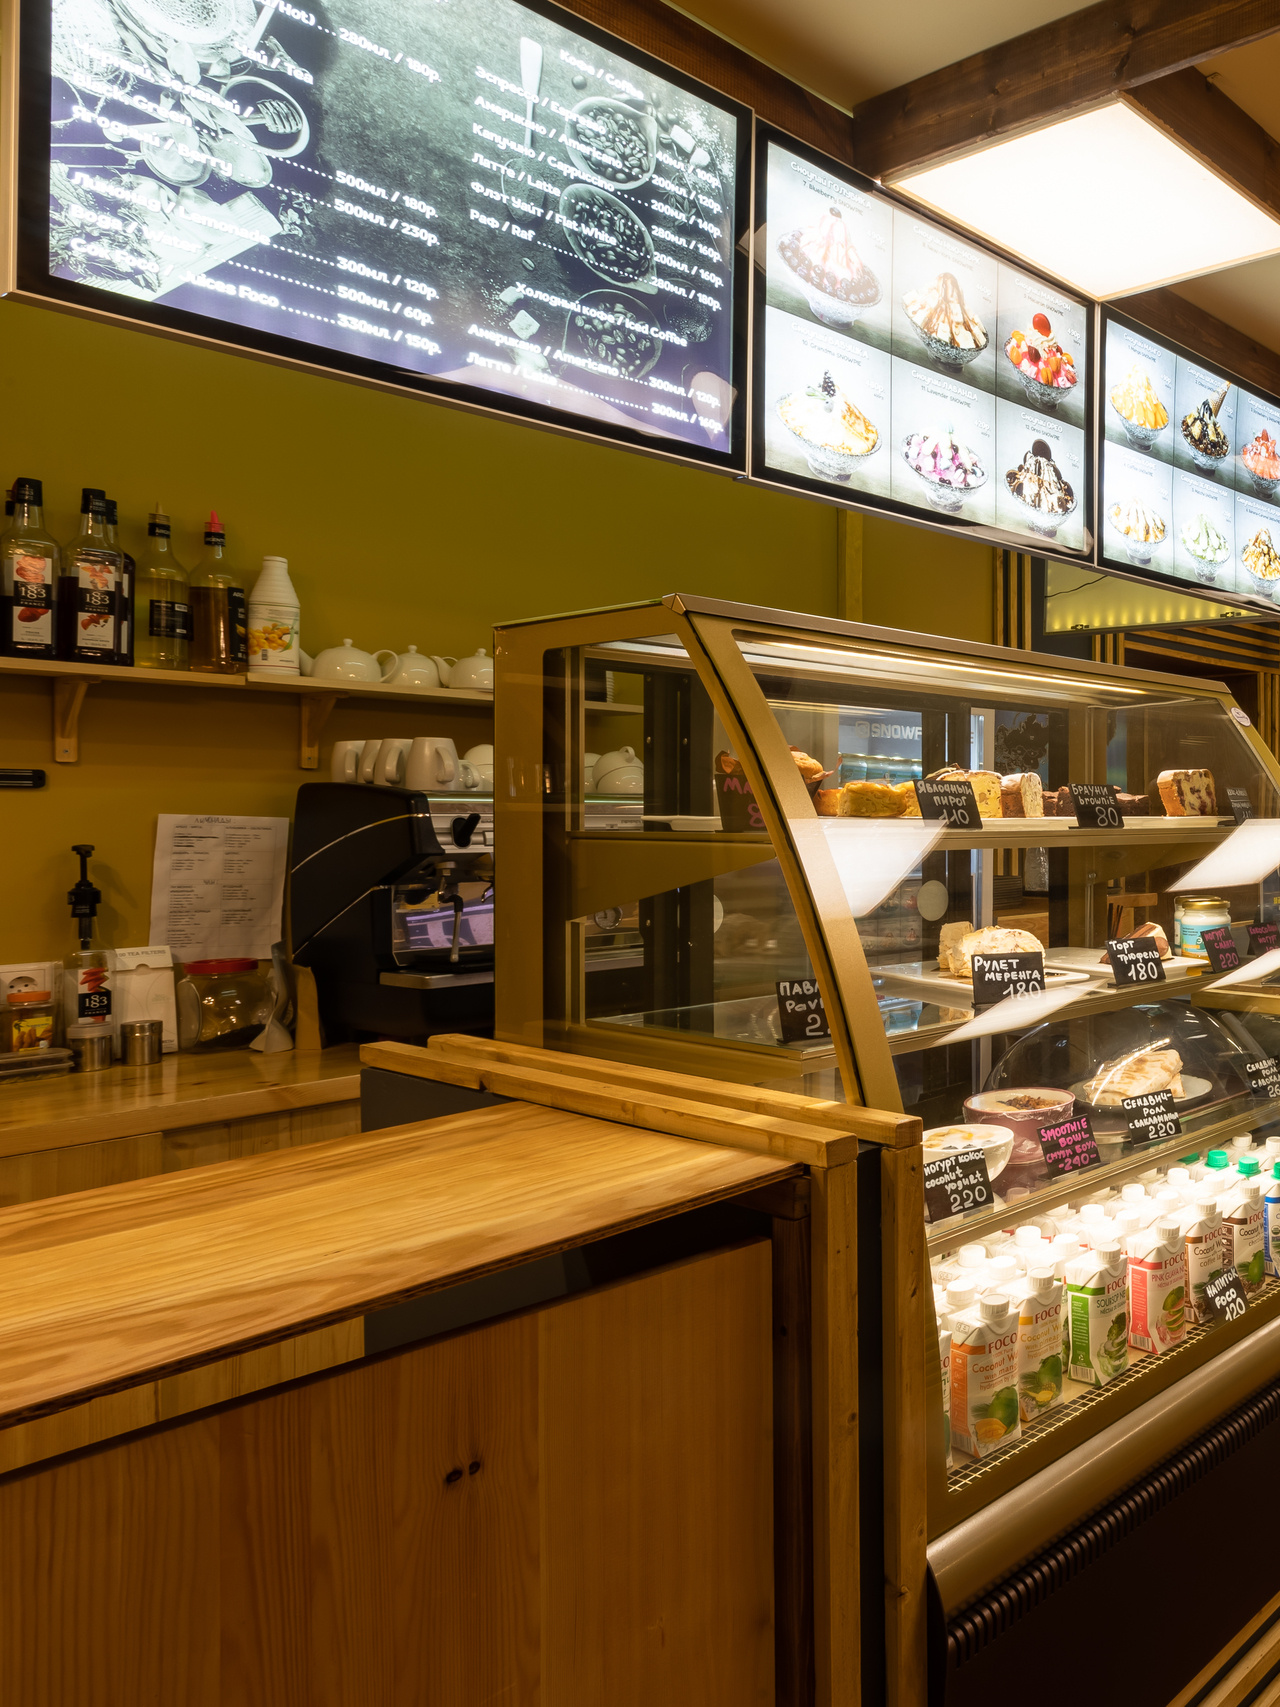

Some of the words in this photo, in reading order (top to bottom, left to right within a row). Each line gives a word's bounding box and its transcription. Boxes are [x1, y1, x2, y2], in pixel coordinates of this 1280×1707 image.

[284, 62, 314, 84] Tea
[475, 66, 540, 104] Эспрессо
[551, 101, 606, 135] Espresso
[133, 95, 192, 127] Green
[335, 170, 388, 200] 500мл.
[403, 194, 438, 218] 180р.
[474, 95, 548, 136] Американо
[558, 133, 623, 169] Americano
[651, 174, 688, 198] 200мл.
[472, 123, 536, 160] Капучино
[547, 154, 615, 192] Cappuccino
[651, 200, 688, 225] 200мл.
[178, 142, 233, 177] Berry
[334, 198, 387, 227] 500мл.
[401, 222, 440, 247] 230р.
[471, 152, 516, 179] Латте
[527, 174, 561, 197] Latte
[651, 225, 688, 247] 280мл.
[809, 184, 838, 204] Blueberry
[838, 199, 864, 216] SNOWPIE
[828, 180, 872, 210] ГОЛУБИКА
[142, 225, 202, 254] Water
[555, 210, 579, 233] Flat
[581, 224, 617, 246] White
[654, 252, 690, 274] 200мл.
[179, 206, 271, 245] Lemonade
[404, 277, 440, 301] 120р.
[470, 209, 499, 230] Раф
[511, 223, 536, 242] Raf
[650, 276, 688, 298] 280мл.
[179, 270, 237, 296] Juices
[238, 285, 280, 308] Foco
[1040, 291, 1071, 311] МАКАРОН
[515, 281, 581, 314] Холодный
[582, 305, 615, 325] кофе
[625, 319, 649, 335] Iced
[649, 328, 688, 347] Coffee
[467, 324, 542, 356] Американо
[553, 350, 619, 377] Americano
[810, 342, 836, 357] Grandma
[837, 353, 862, 367] SNOWPIE
[466, 351, 511, 374] Латте
[927, 387, 949, 401] Lavender
[942, 381, 978, 401] ЛАВАНДА
[1046, 421, 1063, 433] ОРЕО
[1071, 784, 1108, 796] БРАУНИ
[933, 795, 967, 807] ПИРОГ
[938, 809, 970, 825] 110
[1095, 806, 1119, 827] 80
[1108, 940, 1135, 954] Торт
[1117, 950, 1160, 964] трюфель
[1128, 962, 1158, 981] 180
[1219, 953, 1239, 969] 220
[985, 969, 1041, 982] МЕРЕНГА
[1003, 981, 1042, 1000] 180
[1142, 1105, 1166, 1117] РОЛЛ
[1040, 1117, 1088, 1142] SMOOTHIE
[1058, 1131, 1090, 1148] BOWL
[1148, 1121, 1176, 1139] 220
[925, 1166, 963, 1189] coconut
[950, 1186, 987, 1213] 220
[1239, 1226, 1258, 1237] Coconut
[1164, 1251, 1184, 1269] FOCO
[1193, 1244, 1215, 1256] Coconut
[1200, 1256, 1216, 1267] coffee
[1151, 1272, 1165, 1282] PINK
[1165, 1268, 1179, 1280] GUAVA
[1206, 1267, 1239, 1298] НАПИТОК
[1096, 1294, 1119, 1308] SOURSOP
[1214, 1287, 1237, 1309] FOCO
[1225, 1297, 1246, 1321] 120
[988, 1332, 1018, 1354] FOCO
[1020, 1329, 1050, 1343] Coconut
[972, 1358, 1005, 1374] Coconut
[984, 1372, 997, 1381] With
